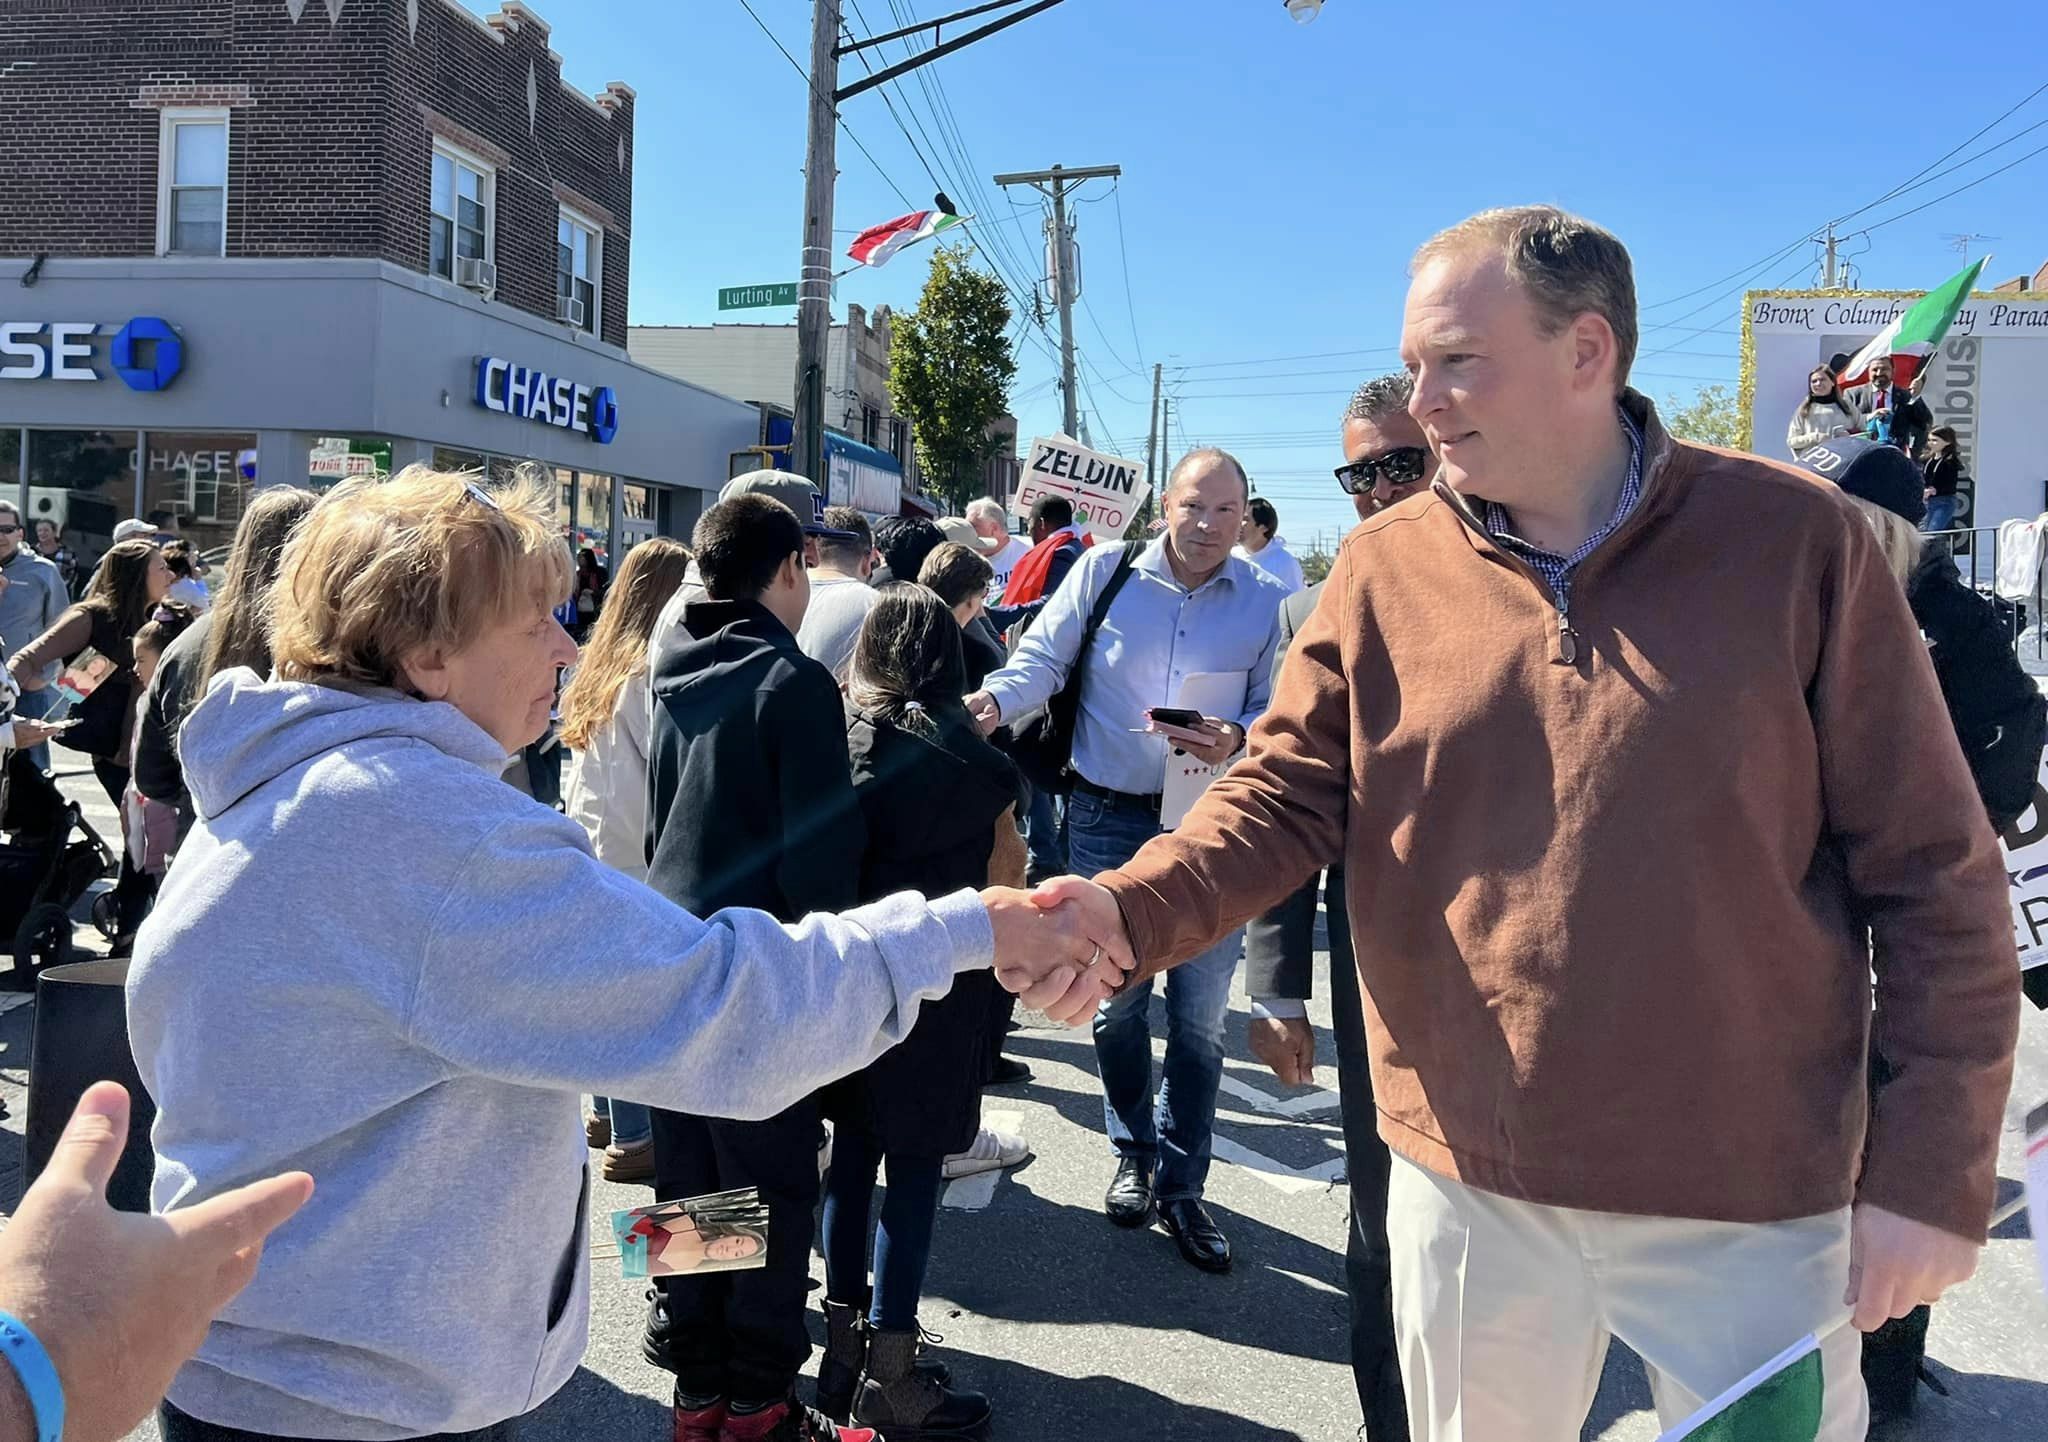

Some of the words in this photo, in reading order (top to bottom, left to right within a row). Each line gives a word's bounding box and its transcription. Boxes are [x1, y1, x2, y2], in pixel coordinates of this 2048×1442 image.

[726, 288, 773, 306] Lurting
[778, 286, 788, 296] Av
[1754, 302, 1815, 330] Bronx
[1824, 300, 1905, 325] Columb
[0, 322, 98, 380] SE
[483, 357, 591, 433] CHASE
[1032, 444, 1137, 495] ZELDIN
